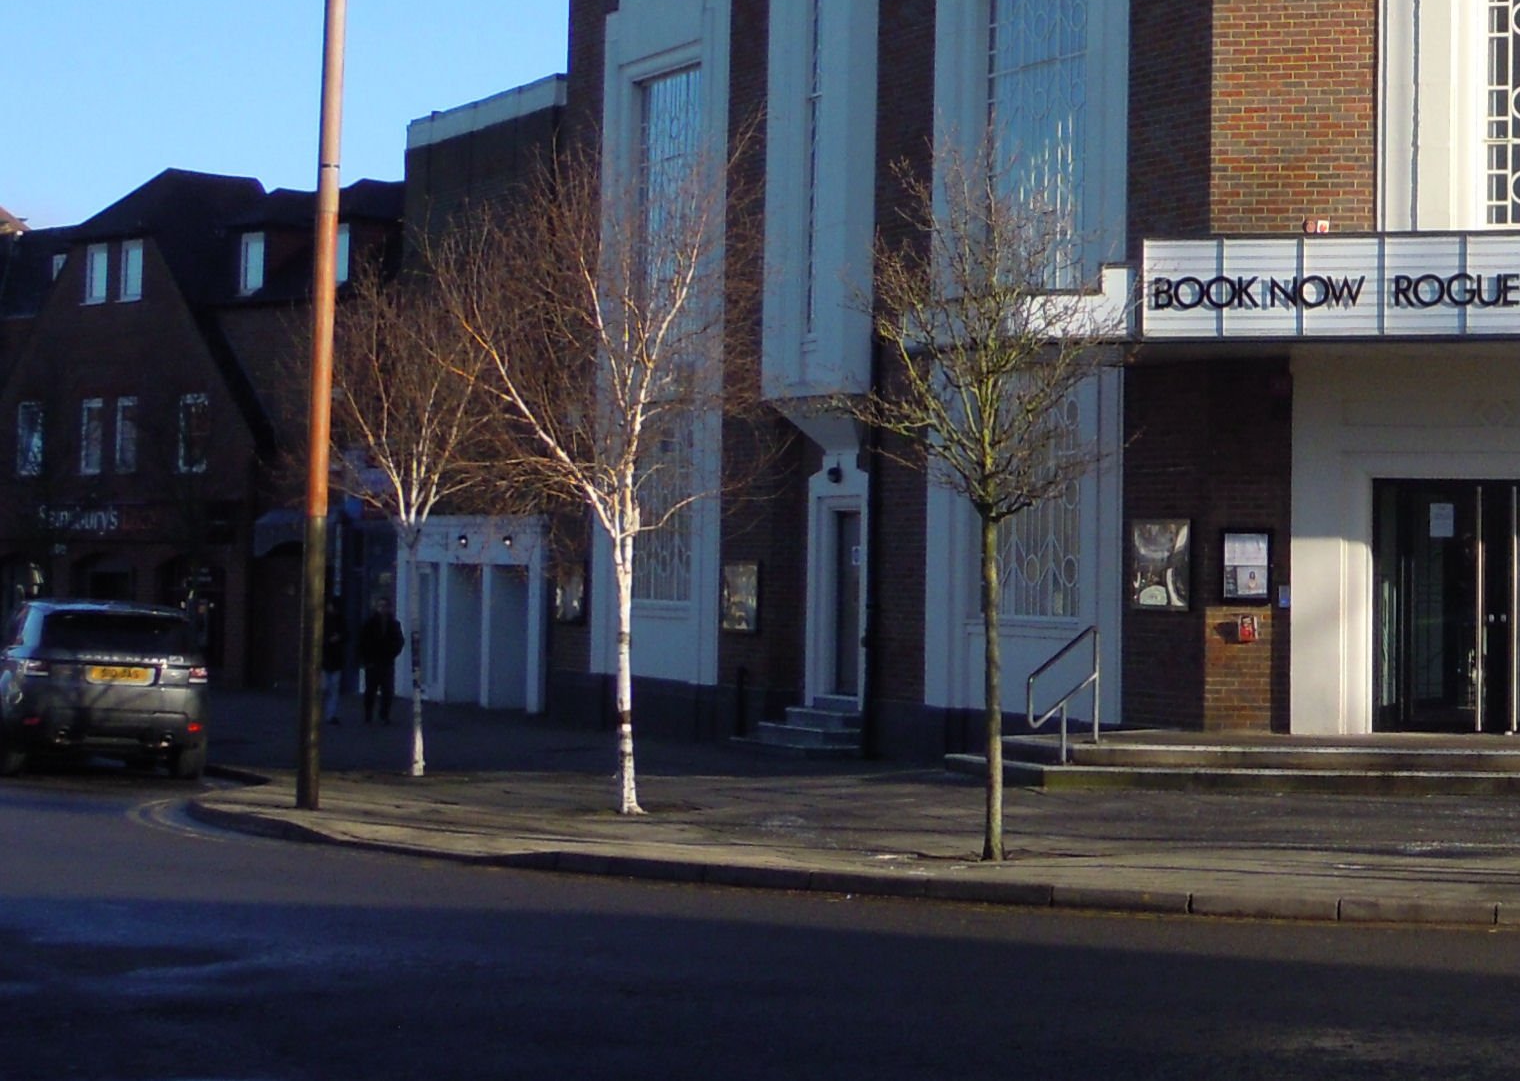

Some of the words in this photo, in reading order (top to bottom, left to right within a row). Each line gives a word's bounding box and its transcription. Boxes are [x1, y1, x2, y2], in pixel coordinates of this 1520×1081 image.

[1154, 275, 1259, 309] BOOK
[1269, 274, 1366, 307] NOW
[1394, 272, 1520, 306] ROGUE
